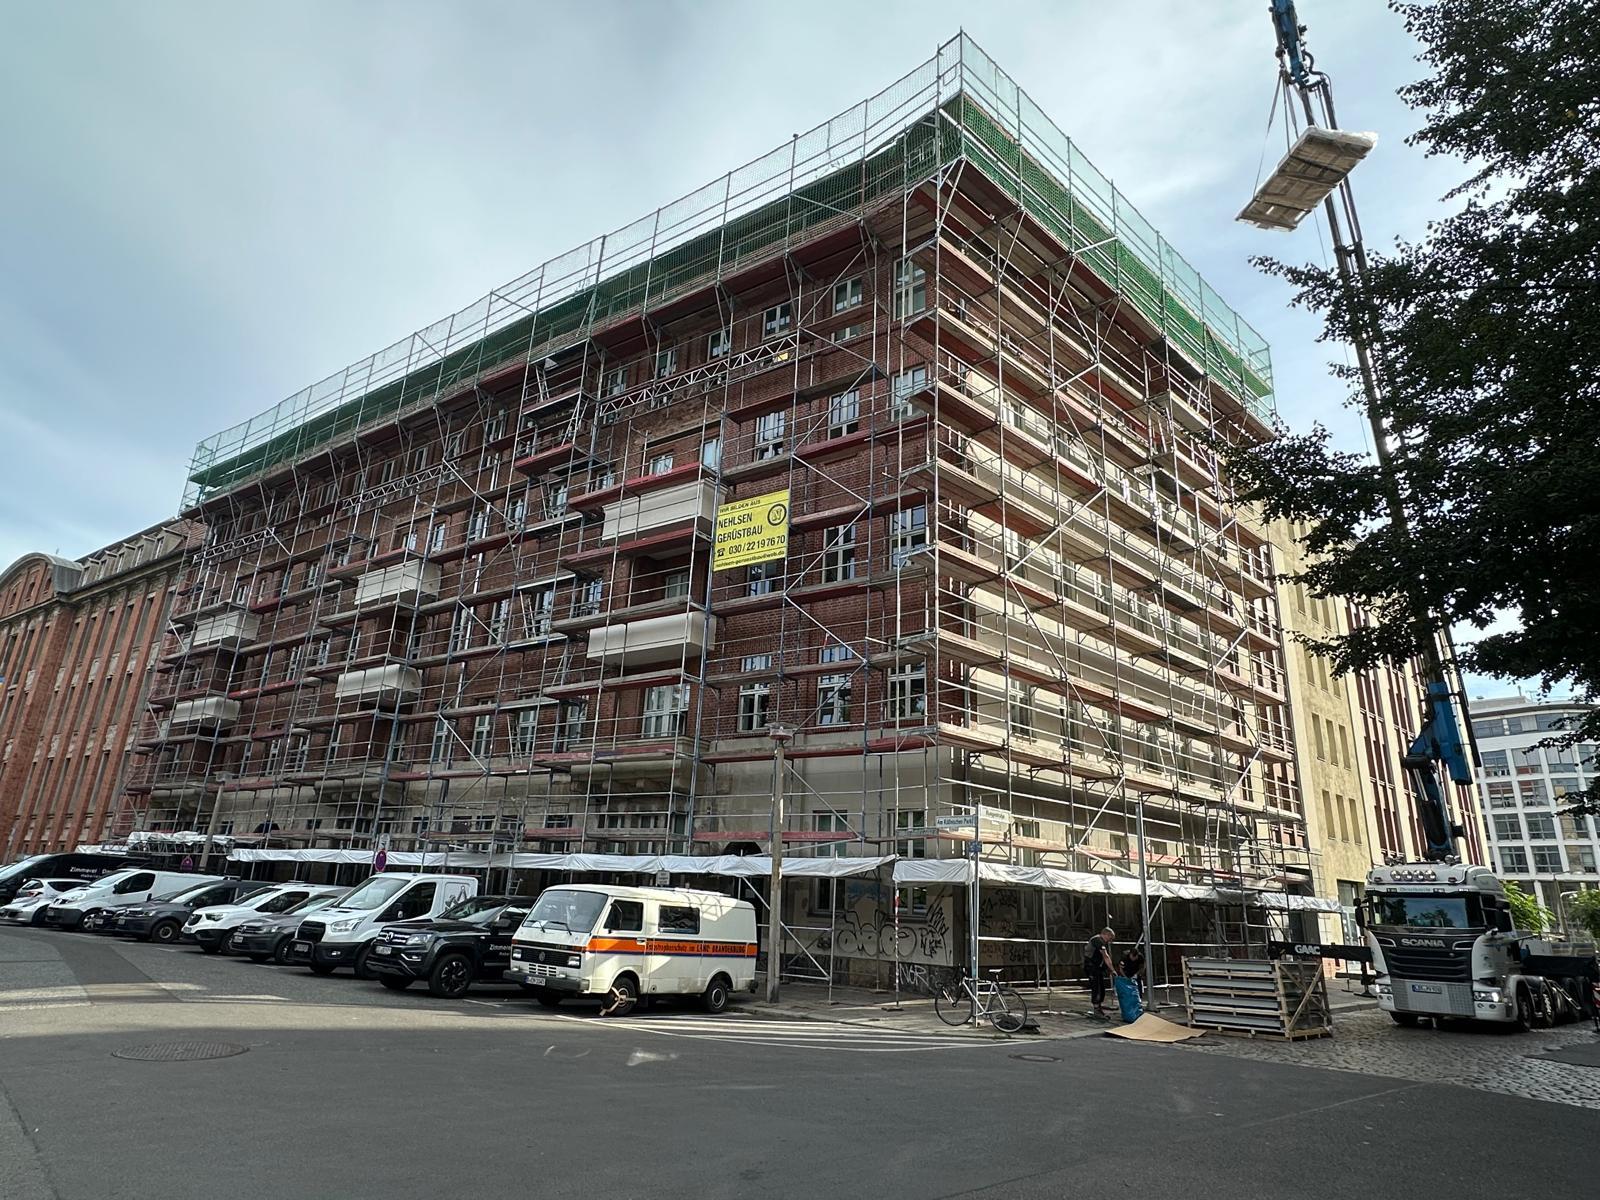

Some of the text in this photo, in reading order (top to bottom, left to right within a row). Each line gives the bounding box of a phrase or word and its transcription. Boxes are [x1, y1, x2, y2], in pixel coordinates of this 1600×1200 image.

[718, 512, 753, 528] NEHLSEN
[717, 524, 763, 544] GERÜSTBAU
[1401, 938, 1446, 948] SCANIA
